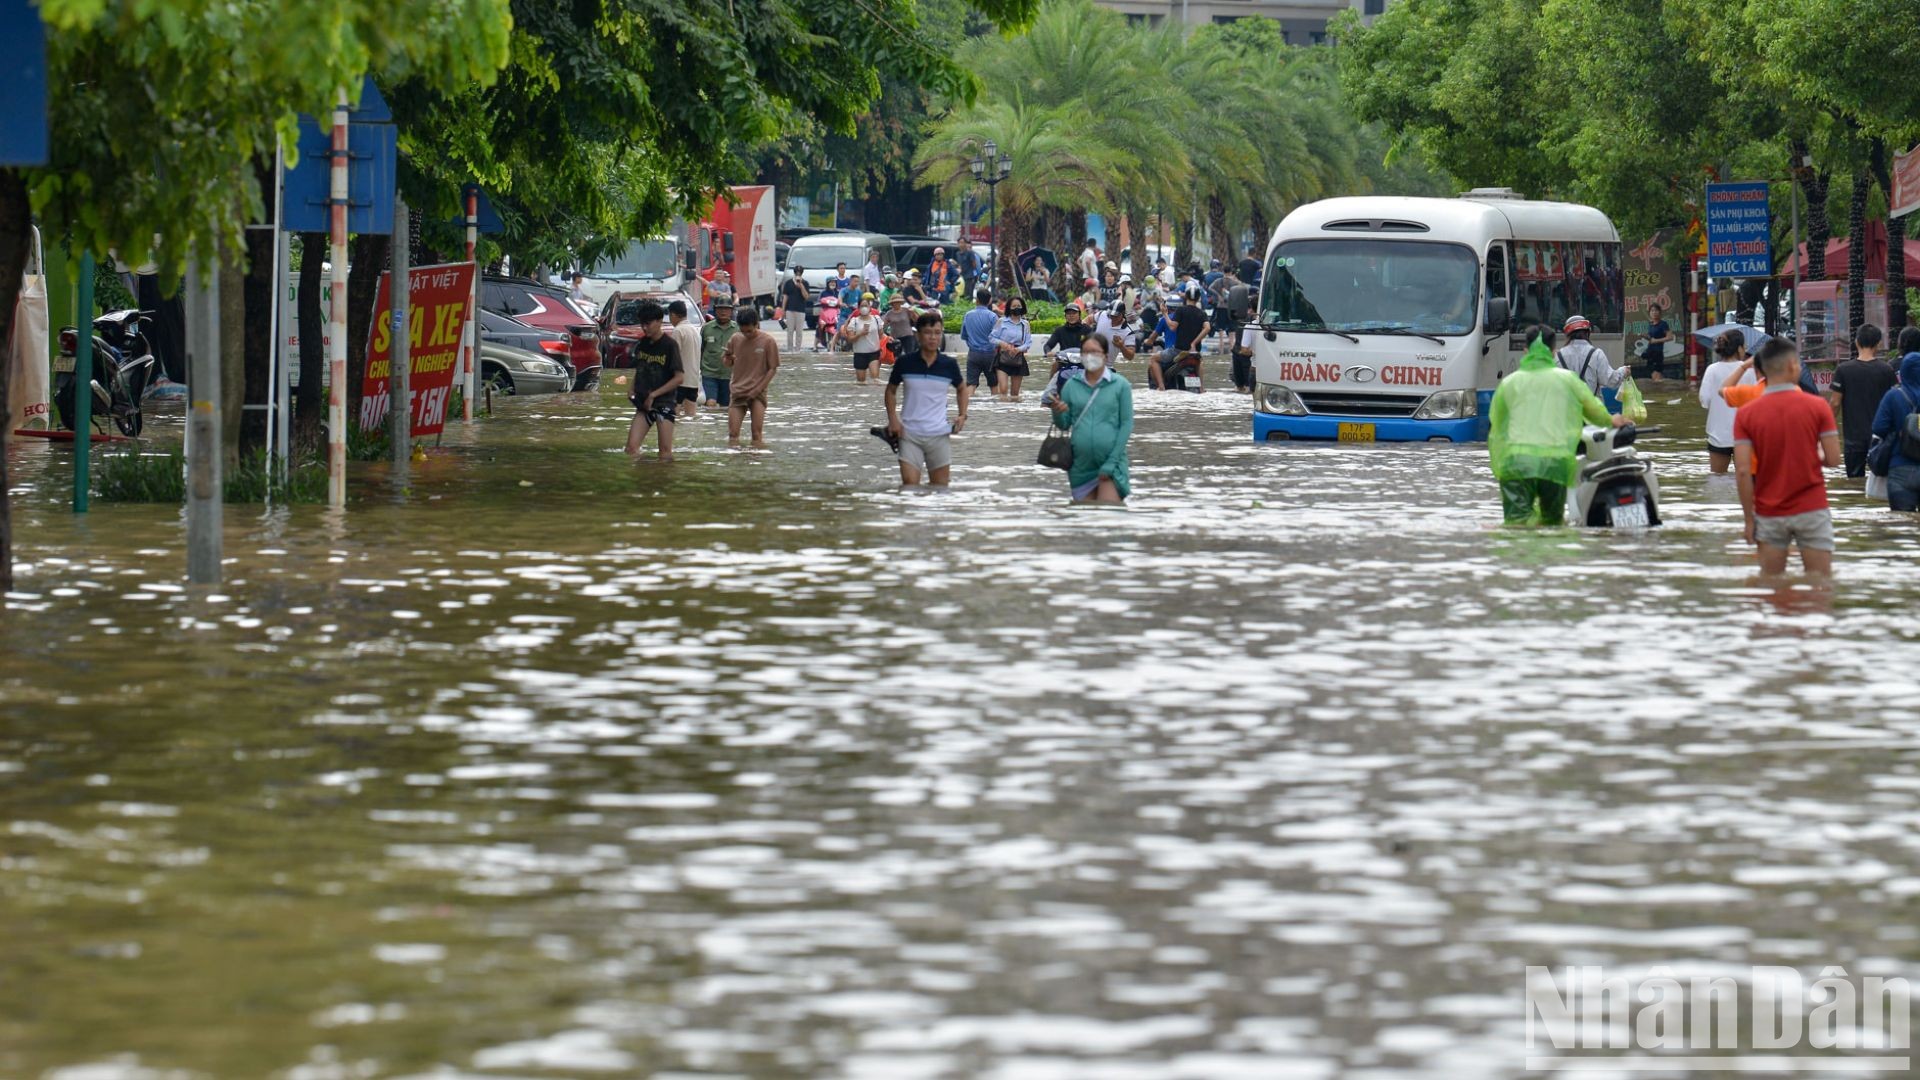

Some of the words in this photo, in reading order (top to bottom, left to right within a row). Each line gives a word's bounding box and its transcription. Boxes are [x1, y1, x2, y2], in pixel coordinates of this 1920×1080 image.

[1743, 208, 1766, 218] KHOA
[1712, 240, 1733, 256] NHÀ
[1735, 236, 1767, 255] THUỐC
[1714, 259, 1740, 273] ĐỨC
[1741, 258, 1767, 272] TÂM
[432, 272, 460, 291] VIỆT
[1624, 269, 1660, 287] ffee
[374, 303, 424, 353] SA
[428, 302, 464, 347] XE
[415, 350, 456, 374] NGHIỆP
[1280, 358, 1341, 382] HOÀNG
[1381, 365, 1443, 386] CHINH
[417, 386, 449, 428] 15K
